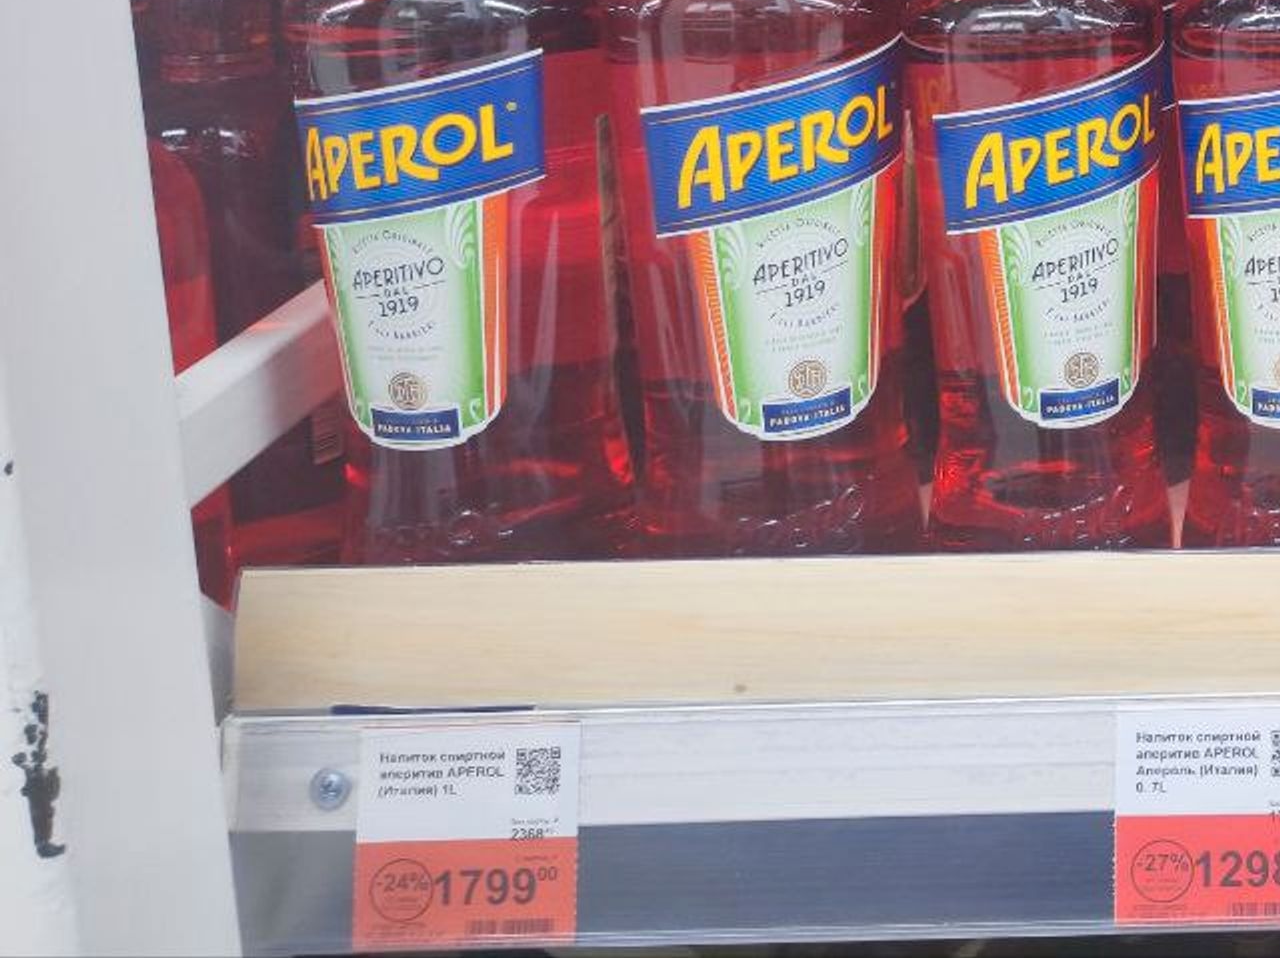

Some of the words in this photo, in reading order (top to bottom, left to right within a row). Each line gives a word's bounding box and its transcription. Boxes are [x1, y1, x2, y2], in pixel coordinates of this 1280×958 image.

[306, 104, 514, 202] APEROL
[678, 84, 893, 210] APEROL
[964, 93, 1155, 209] APEROL
[353, 256, 445, 290] APERITIVO
[753, 238, 848, 285] APERITIVO
[1032, 238, 1119, 282] APERITIVO
[785, 280, 825, 307] 1919
[1060, 277, 1098, 303] 1919
[379, 296, 419, 317] 1919
[1203, 746, 1258, 760] APEROL
[447, 765, 504, 779] APEROL
[1199, 763, 1258, 778] (Италия)
[511, 827, 544, 841] 2368
[1137, 853, 1190, 873] -27%
[376, 872, 428, 892] -24%
[434, 867, 536, 906] 1799
[537, 866, 558, 881] 00
